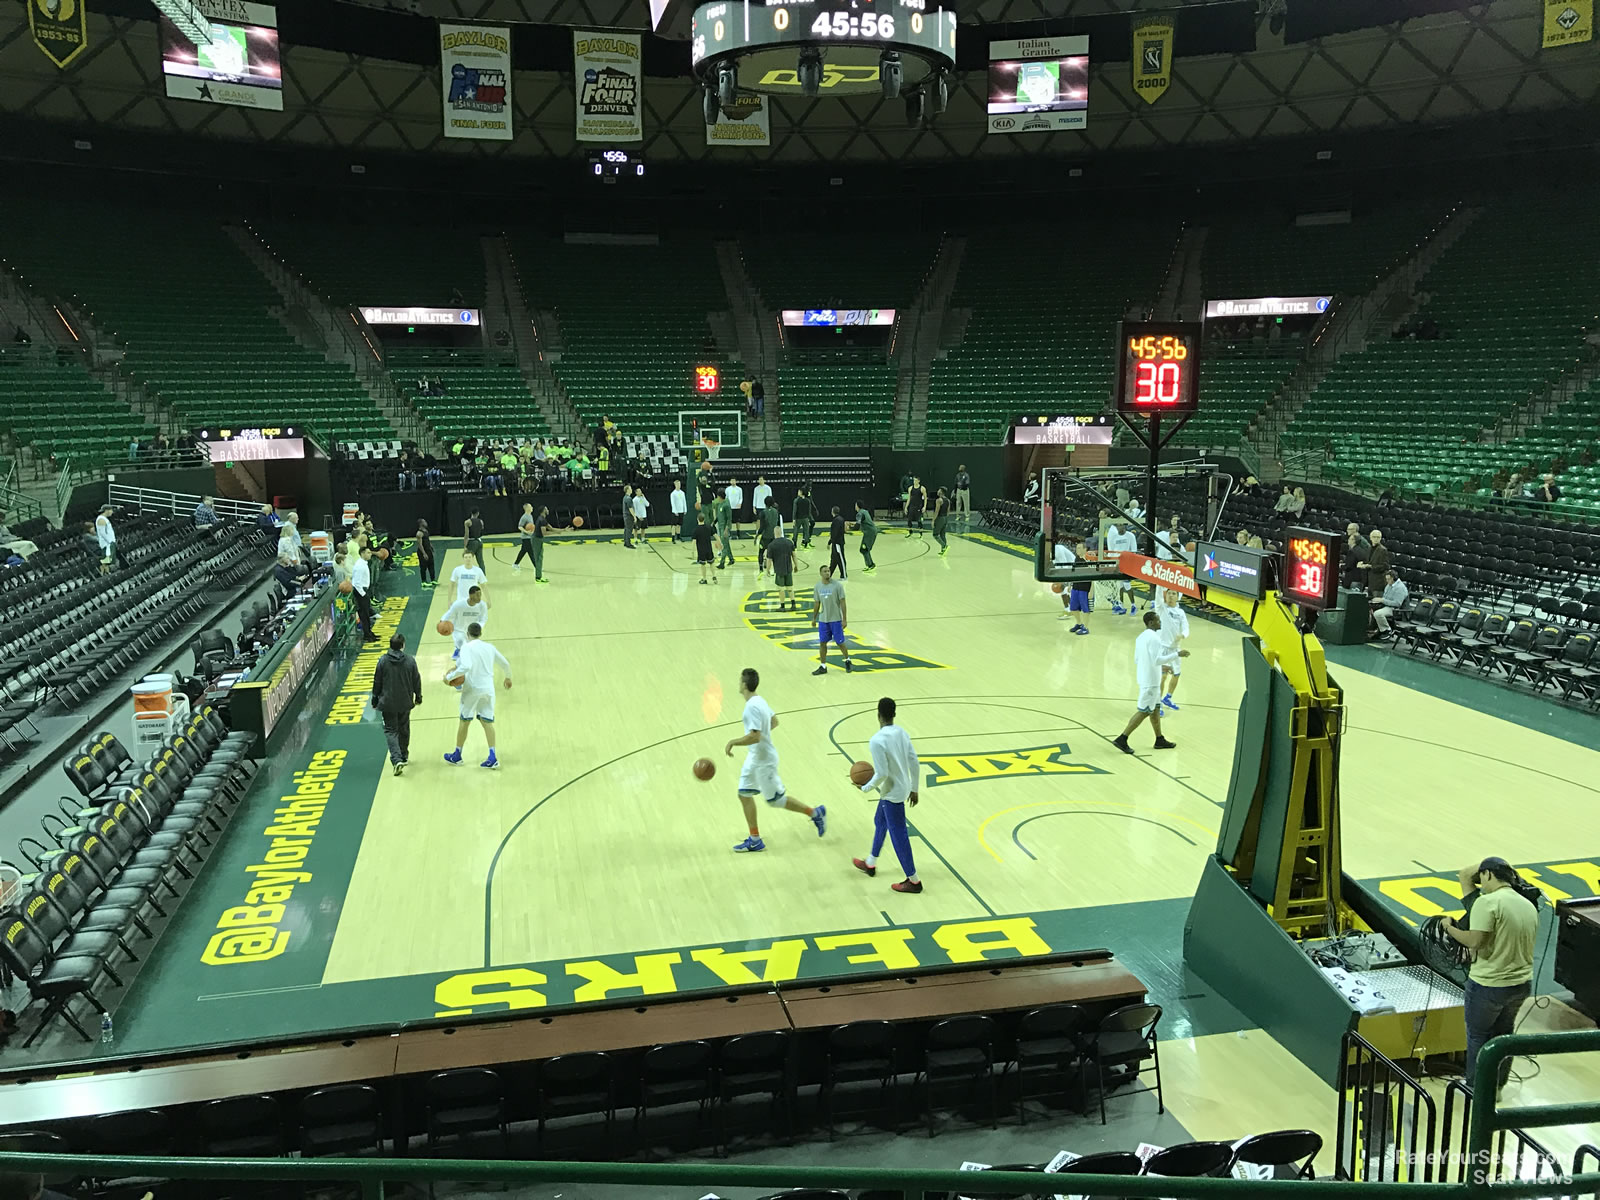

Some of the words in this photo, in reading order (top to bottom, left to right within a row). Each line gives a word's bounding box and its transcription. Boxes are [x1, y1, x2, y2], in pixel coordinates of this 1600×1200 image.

[773, 8, 789, 30] 0
[811, 11, 895, 39] 45:56
[911, 12, 923, 34] 0
[714, 20, 724, 41] 0
[443, 31, 508, 53] BAYLOR
[576, 38, 639, 59] BAYLOR
[1017, 39, 1050, 49] Italian
[1022, 47, 1060, 57] Granite
[597, 73, 634, 89] FINAL
[1137, 77, 1166, 88] 2000
[583, 83, 635, 105] FOUR
[738, 97, 761, 105] FOUR
[590, 104, 629, 113] DENVER
[451, 119, 479, 128] FINAL
[481, 121, 506, 129] FOUR
[714, 123, 761, 132] NATIONAL
[995, 120, 1012, 128] KIA
[711, 131, 766, 140] CHAMPIONS
[595, 163, 602, 175] 0
[637, 164, 644, 175] 0
[1131, 336, 1187, 360] 45:56
[699, 375, 715, 390] 30
[1136, 362, 1180, 403] 30
[1036, 435, 1091, 444] BASKETBALL
[220, 448, 280, 461] BASKETBALL
[325, 694, 370, 725] 2005
[200, 749, 348, 966] @BaylorAthletics
